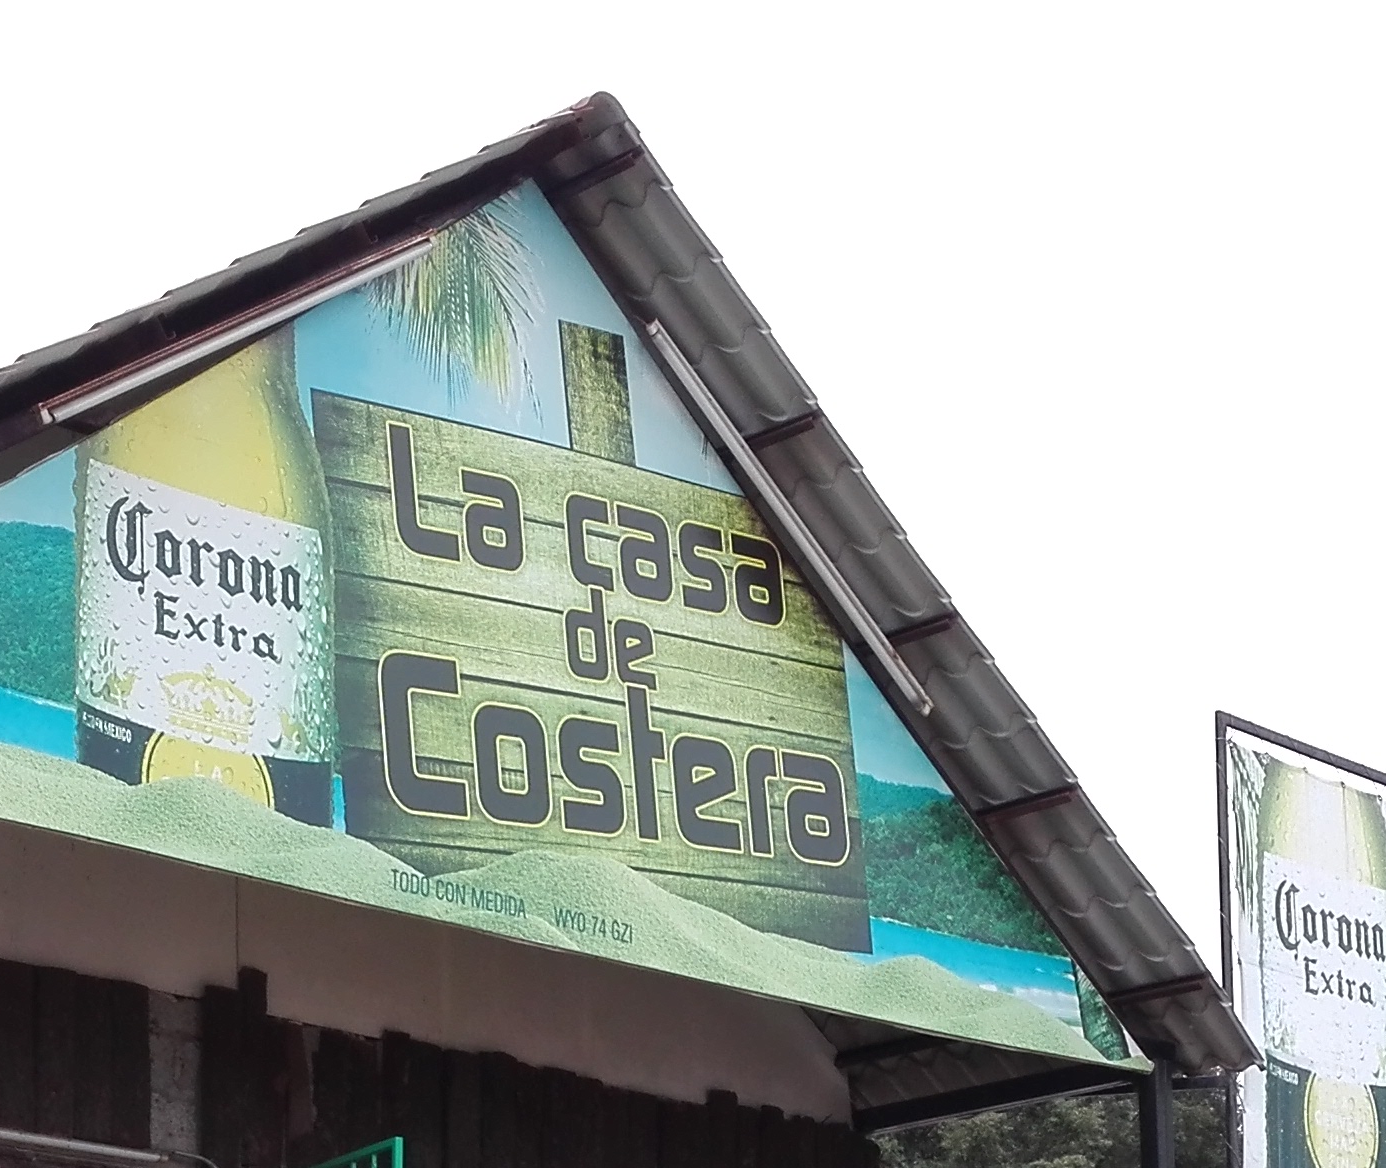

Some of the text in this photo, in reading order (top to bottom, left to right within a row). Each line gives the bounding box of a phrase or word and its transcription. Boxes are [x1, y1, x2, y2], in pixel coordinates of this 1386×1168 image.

[106, 496, 303, 612] Corona
[386, 420, 787, 629] La casa
[154, 590, 281, 663] Extra
[564, 587, 657, 690] de
[377, 648, 852, 868] Costera
[391, 868, 633, 944] TODO CON MEDIDA WYO 74 GZI
[1274, 880, 1386, 965] Corona
[1304, 955, 1376, 1007] Extra
